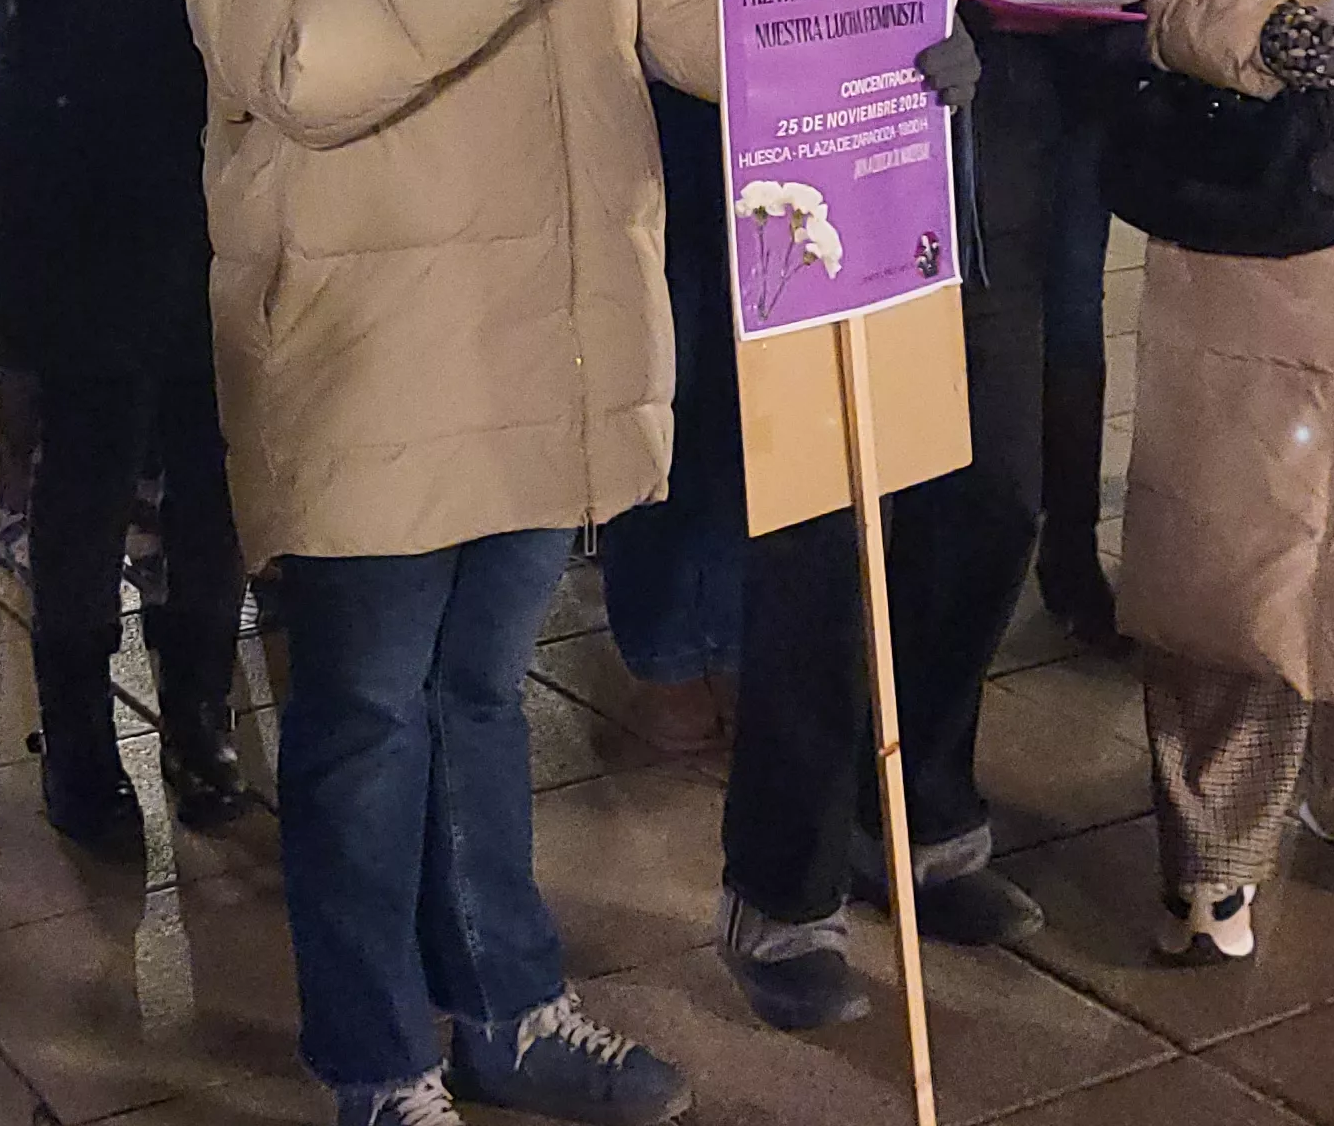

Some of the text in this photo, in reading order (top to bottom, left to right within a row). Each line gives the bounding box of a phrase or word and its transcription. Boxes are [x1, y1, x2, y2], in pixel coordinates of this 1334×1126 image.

[755, 1, 924, 49] NUESTRA LUCHA FEMINISTA
[841, 67, 924, 99] CONCENTRACI
[776, 91, 928, 137] 25 DE NOVIEMBRE 2025
[739, 146, 792, 169] HUESCA
[798, 139, 837, 159] PLAZA
[837, 136, 852, 152] DE
